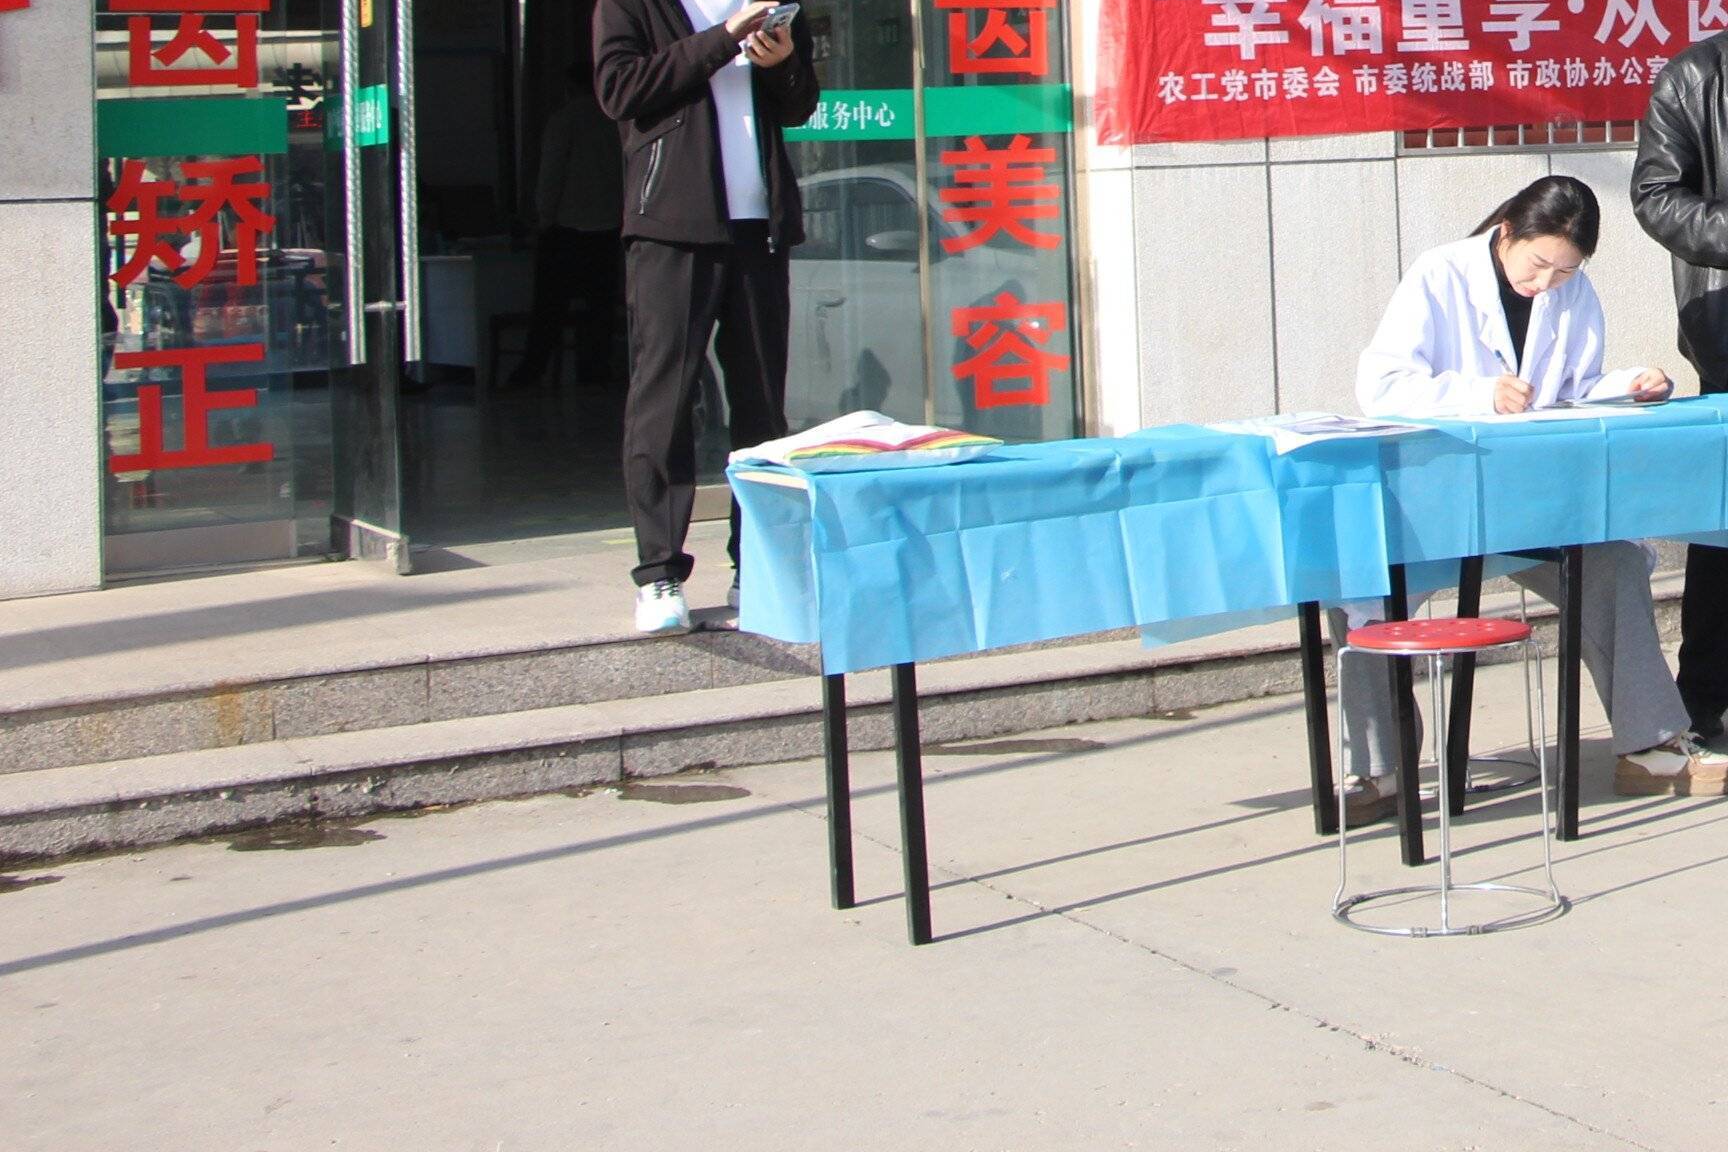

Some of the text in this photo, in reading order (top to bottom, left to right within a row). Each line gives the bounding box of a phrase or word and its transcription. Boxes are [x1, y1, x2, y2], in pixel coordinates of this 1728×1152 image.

[1157, 65, 1341, 105] 农工党市委会
[1353, 59, 1493, 96] 市委统战部
